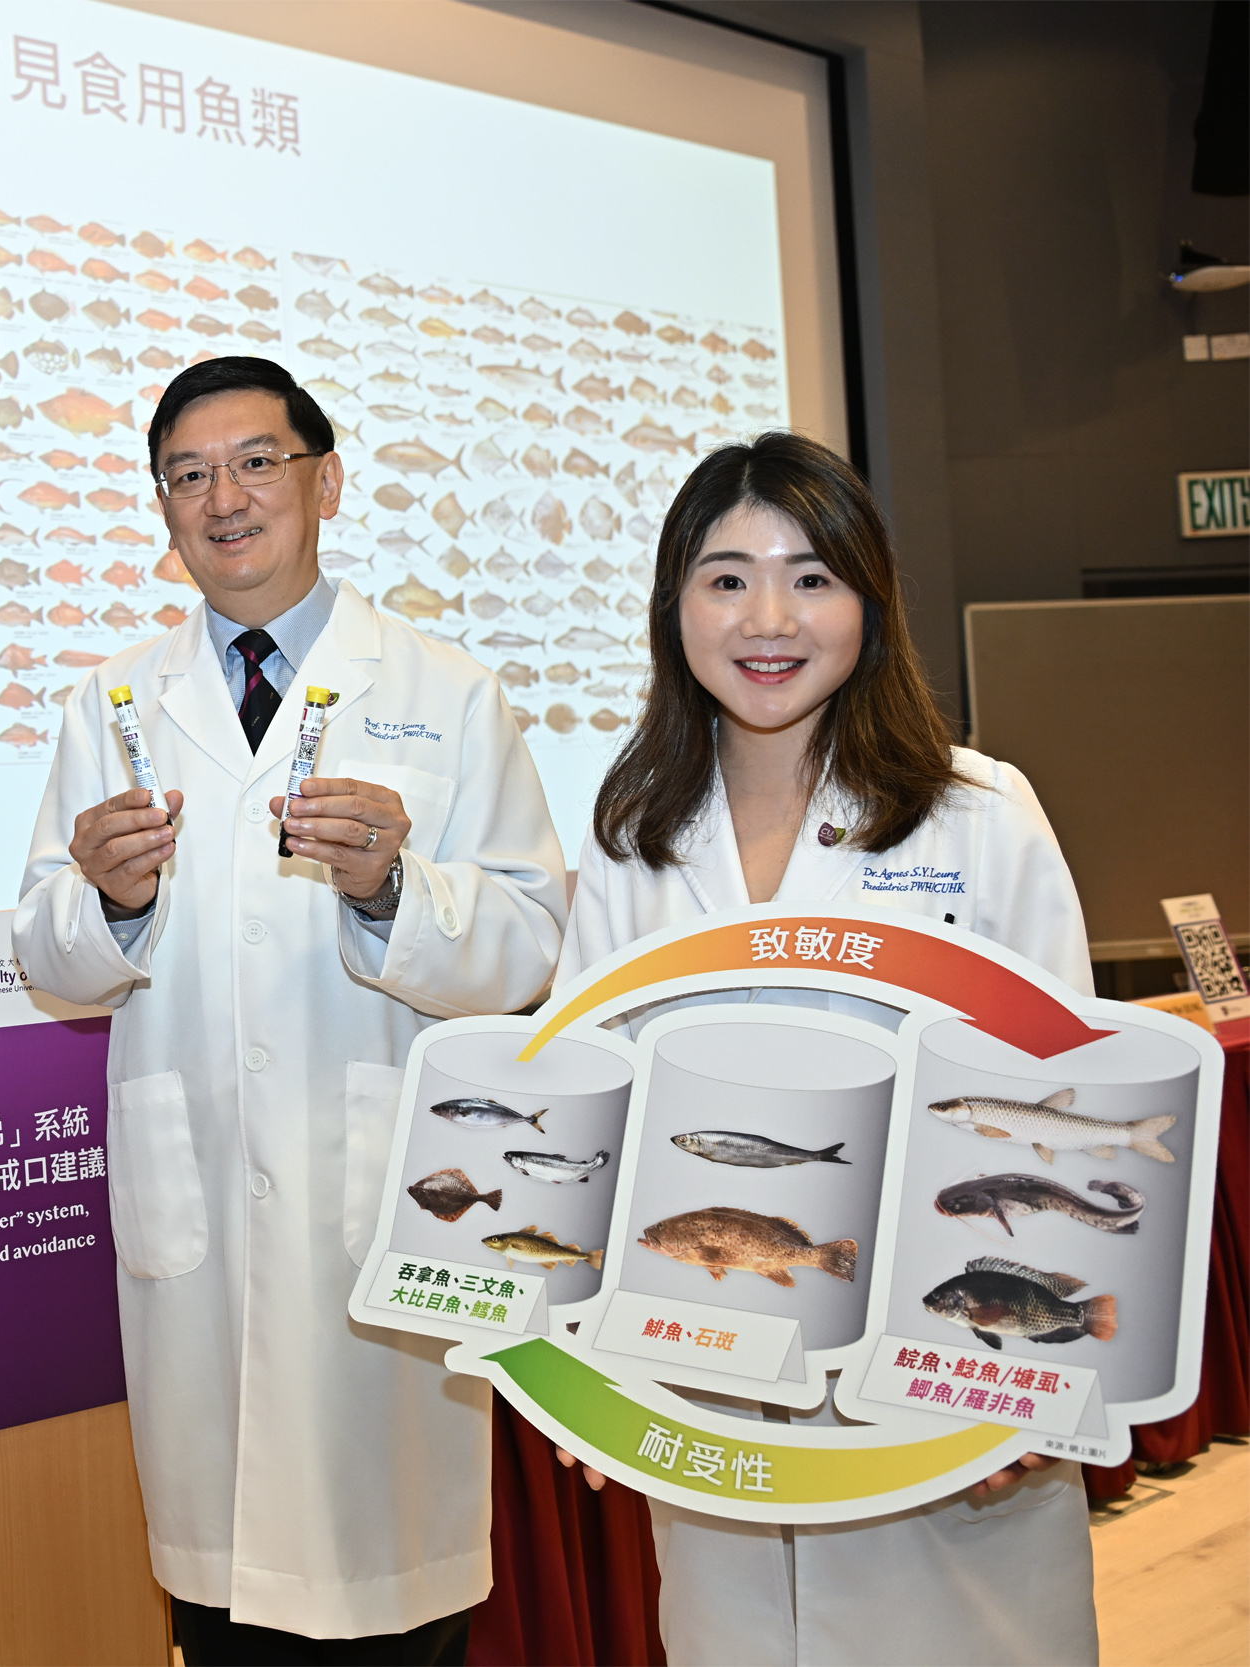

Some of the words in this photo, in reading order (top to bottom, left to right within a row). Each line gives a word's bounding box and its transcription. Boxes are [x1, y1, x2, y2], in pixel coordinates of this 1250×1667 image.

[1188, 478, 1238, 530] EXIT
[364, 717, 380, 730] Prof.
[400, 723, 426, 731] Leung
[862, 880, 909, 891] Paediatrics
[930, 867, 961, 880] Leung
[749, 925, 884, 970] 致敏度
[27, 1204, 90, 1227] system,
[13, 1233, 96, 1259] avoidance
[397, 1263, 525, 1299] 吞拿魚、三文魚、
[641, 1317, 738, 1351] 鯡魚、石斑
[905, 1377, 1036, 1420] 鯽魚/羅非魚
[636, 1421, 774, 1493] 耐受性
